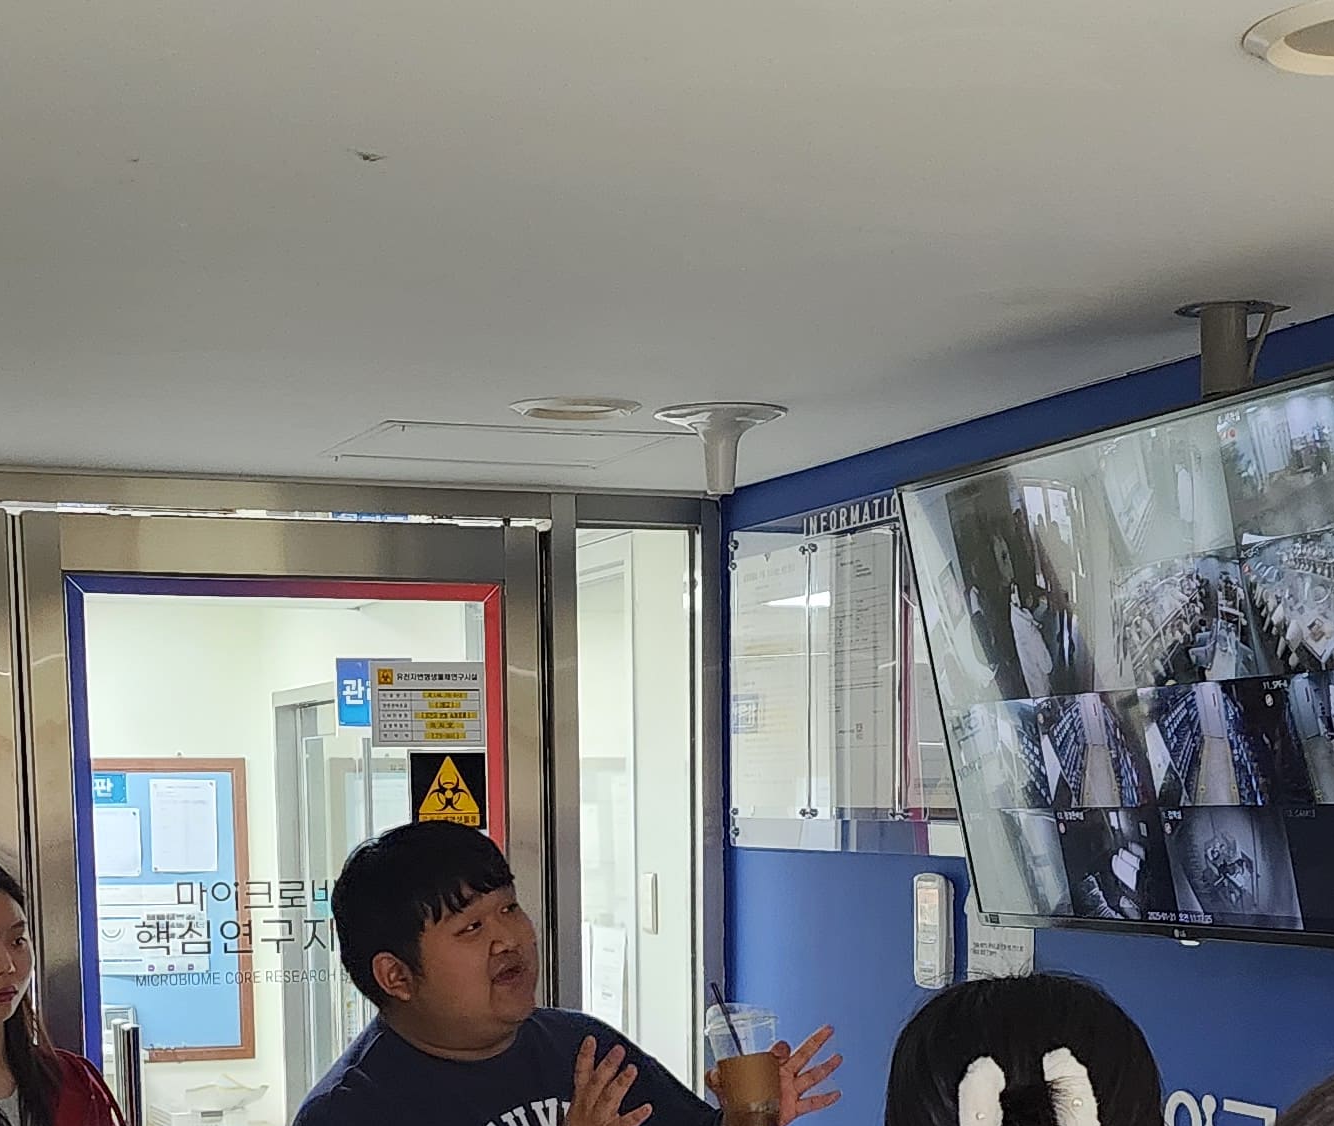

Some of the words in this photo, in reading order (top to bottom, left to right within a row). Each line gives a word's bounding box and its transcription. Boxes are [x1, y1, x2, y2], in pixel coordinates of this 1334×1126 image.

[342, 678, 371, 705] 관
[135, 970, 221, 987] MICROBIOME
[225, 970, 261, 985] CORE
[265, 969, 339, 983] RESEARCH
